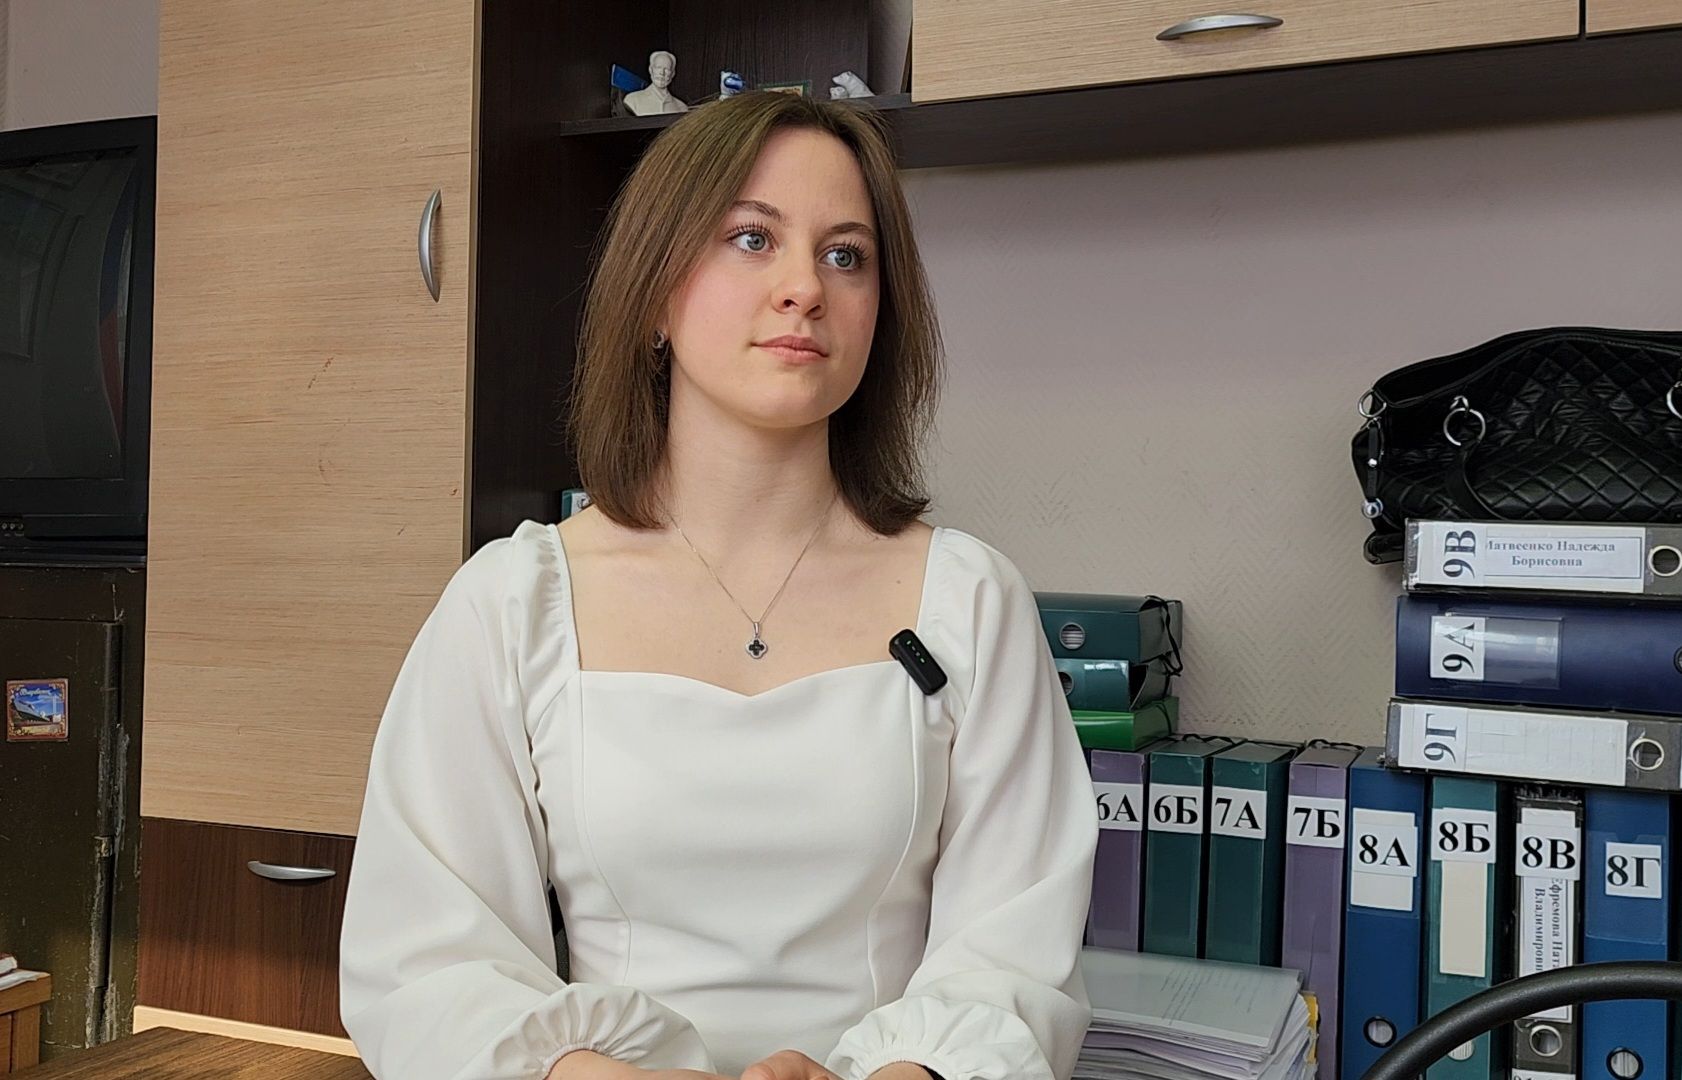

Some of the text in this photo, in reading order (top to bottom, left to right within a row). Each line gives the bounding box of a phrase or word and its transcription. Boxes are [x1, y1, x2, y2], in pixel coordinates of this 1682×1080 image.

[1442, 529, 1477, 579] 9В
[1512, 555, 1582, 568] Борисовна
[1557, 541, 1615, 552] Надежда
[1442, 622, 1475, 674] 9А
[1423, 713, 1457, 764] 9Г
[1097, 793, 1140, 823] 6А
[1153, 794, 1198, 825] 6Б
[1215, 797, 1262, 830] 7А
[1293, 806, 1341, 838] 7Б
[1359, 834, 1411, 867] 8А
[1438, 821, 1491, 853] 8Б
[1521, 836, 1576, 870] 8В
[1607, 855, 1660, 888] 8Г
[1532, 888, 1546, 971] Владимировн
